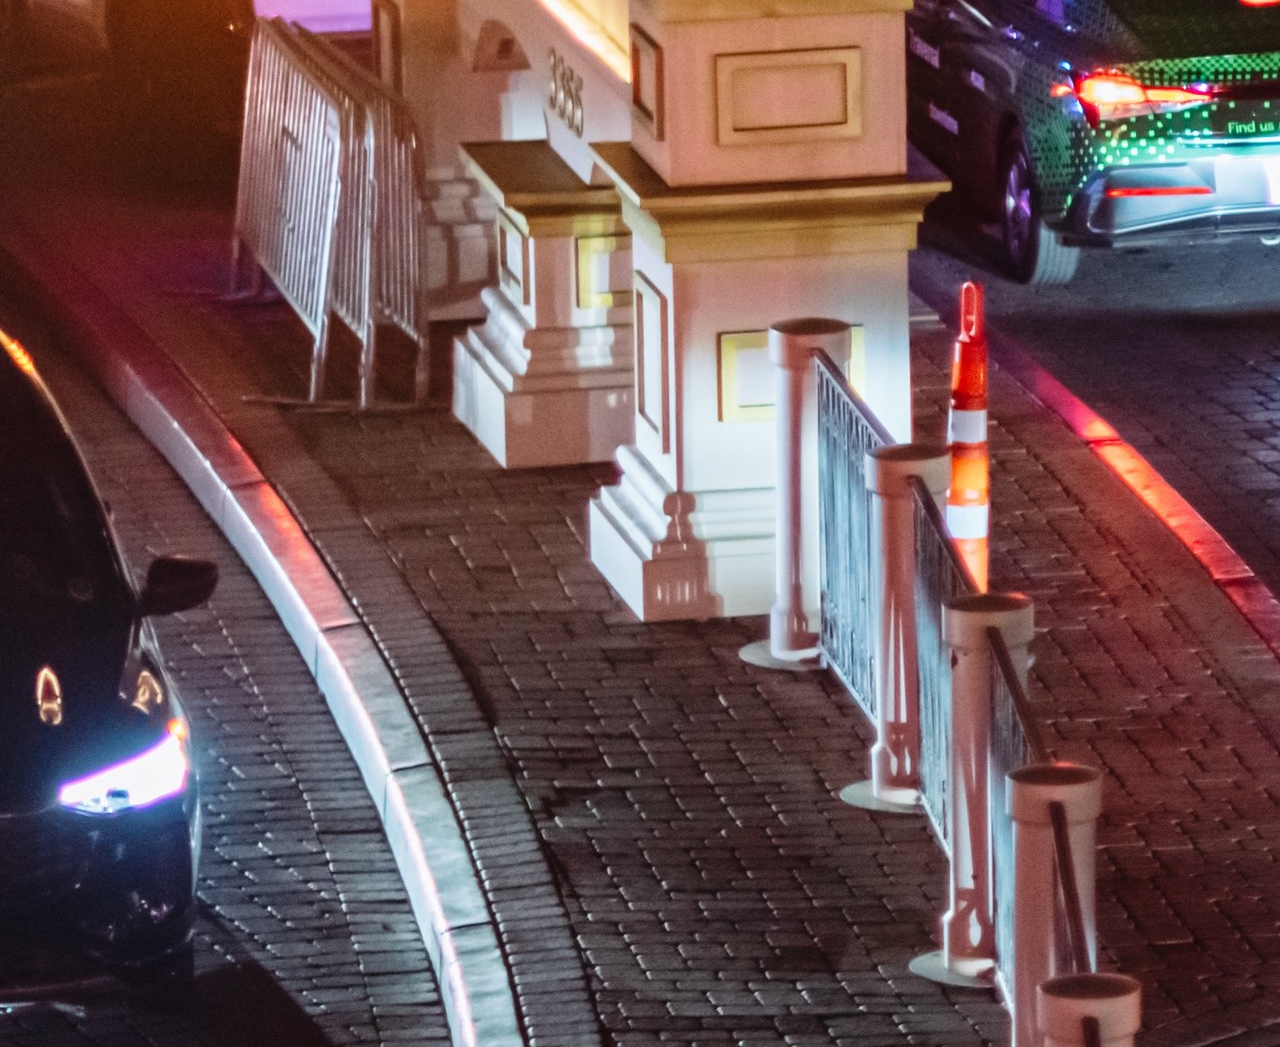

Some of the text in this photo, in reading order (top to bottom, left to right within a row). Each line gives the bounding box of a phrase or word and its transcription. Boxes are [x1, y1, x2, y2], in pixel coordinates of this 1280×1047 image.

[548, 46, 584, 139] 3355
[1228, 121, 1256, 134] Find
[1259, 122, 1275, 133] us
